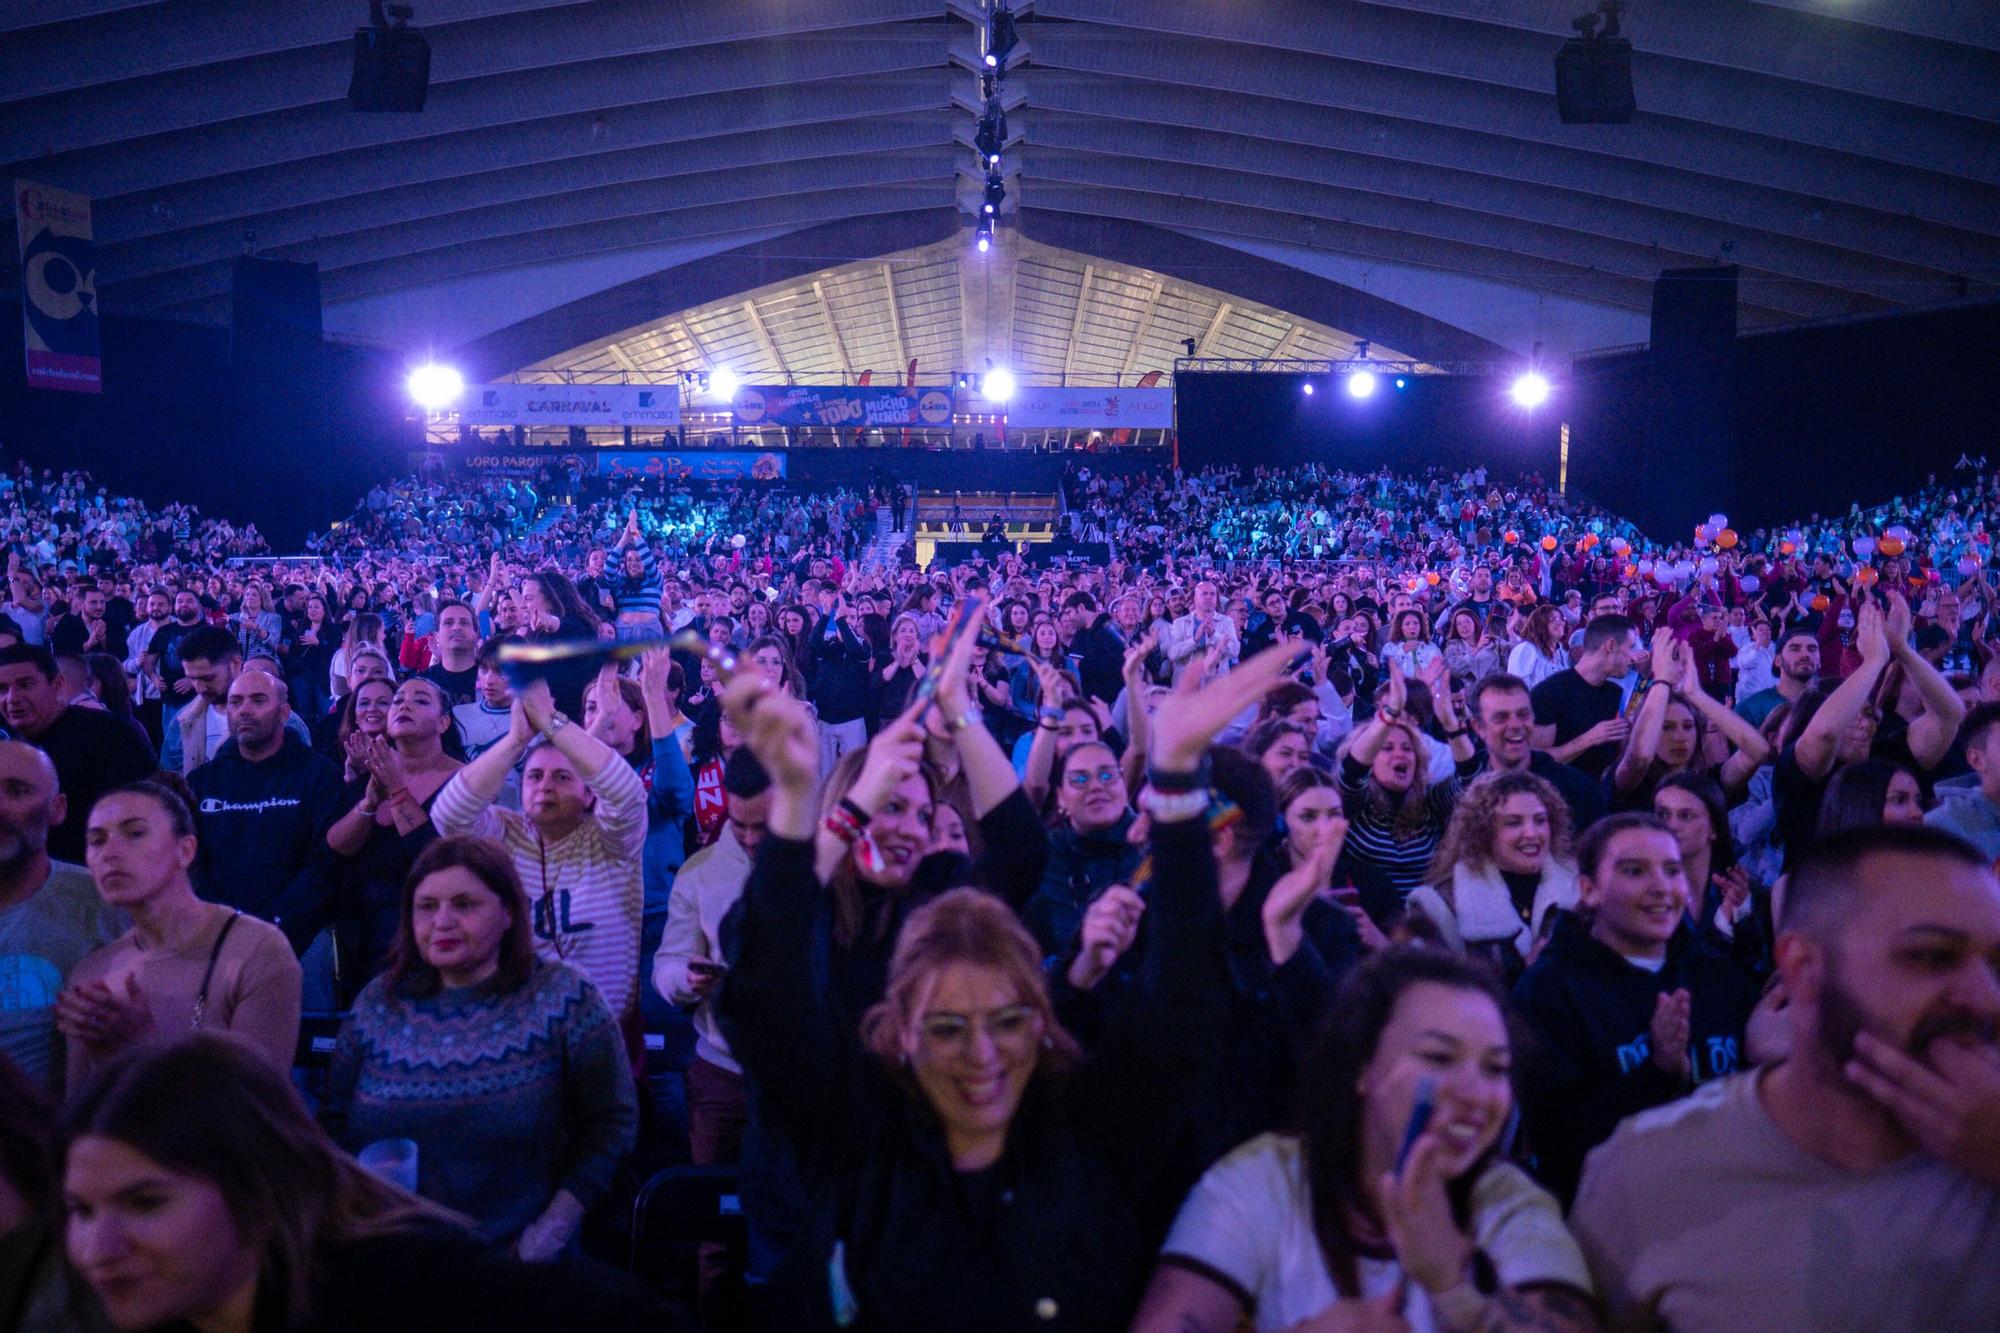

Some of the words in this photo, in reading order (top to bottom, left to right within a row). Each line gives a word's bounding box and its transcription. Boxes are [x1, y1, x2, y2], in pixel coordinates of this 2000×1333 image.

[527, 400, 612, 413] CARNAVAL
[817, 398, 863, 425] TODO
[865, 396, 909, 413] MUCHO
[466, 409, 518, 419] emmasa
[622, 409, 673, 420] emmasa
[866, 409, 910, 425] MENOS
[466, 456, 500, 467] LORO
[200, 797, 300, 813] Champion
